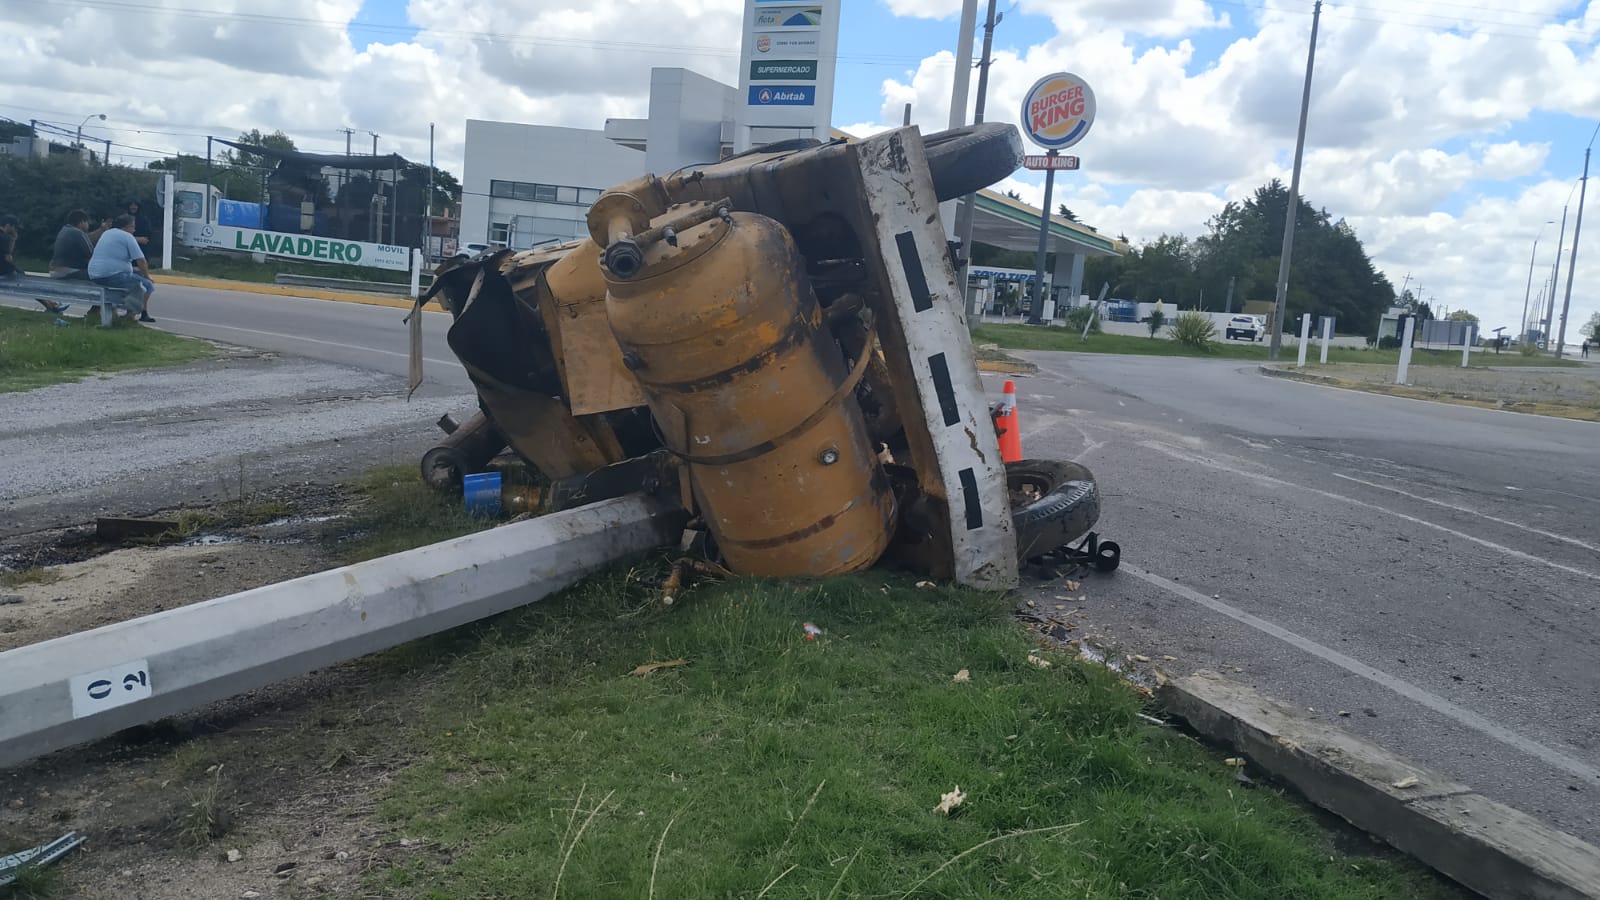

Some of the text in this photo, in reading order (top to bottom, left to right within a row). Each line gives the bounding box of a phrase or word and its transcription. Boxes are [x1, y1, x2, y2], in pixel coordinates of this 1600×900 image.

[757, 66, 811, 74] SUPERMERCADO
[1031, 85, 1083, 115] BURGER
[1032, 98, 1085, 134] KING
[1025, 157, 1073, 168] AUTO KING
[235, 230, 362, 262] LAVADERO
[974, 270, 1006, 280] TOYO
